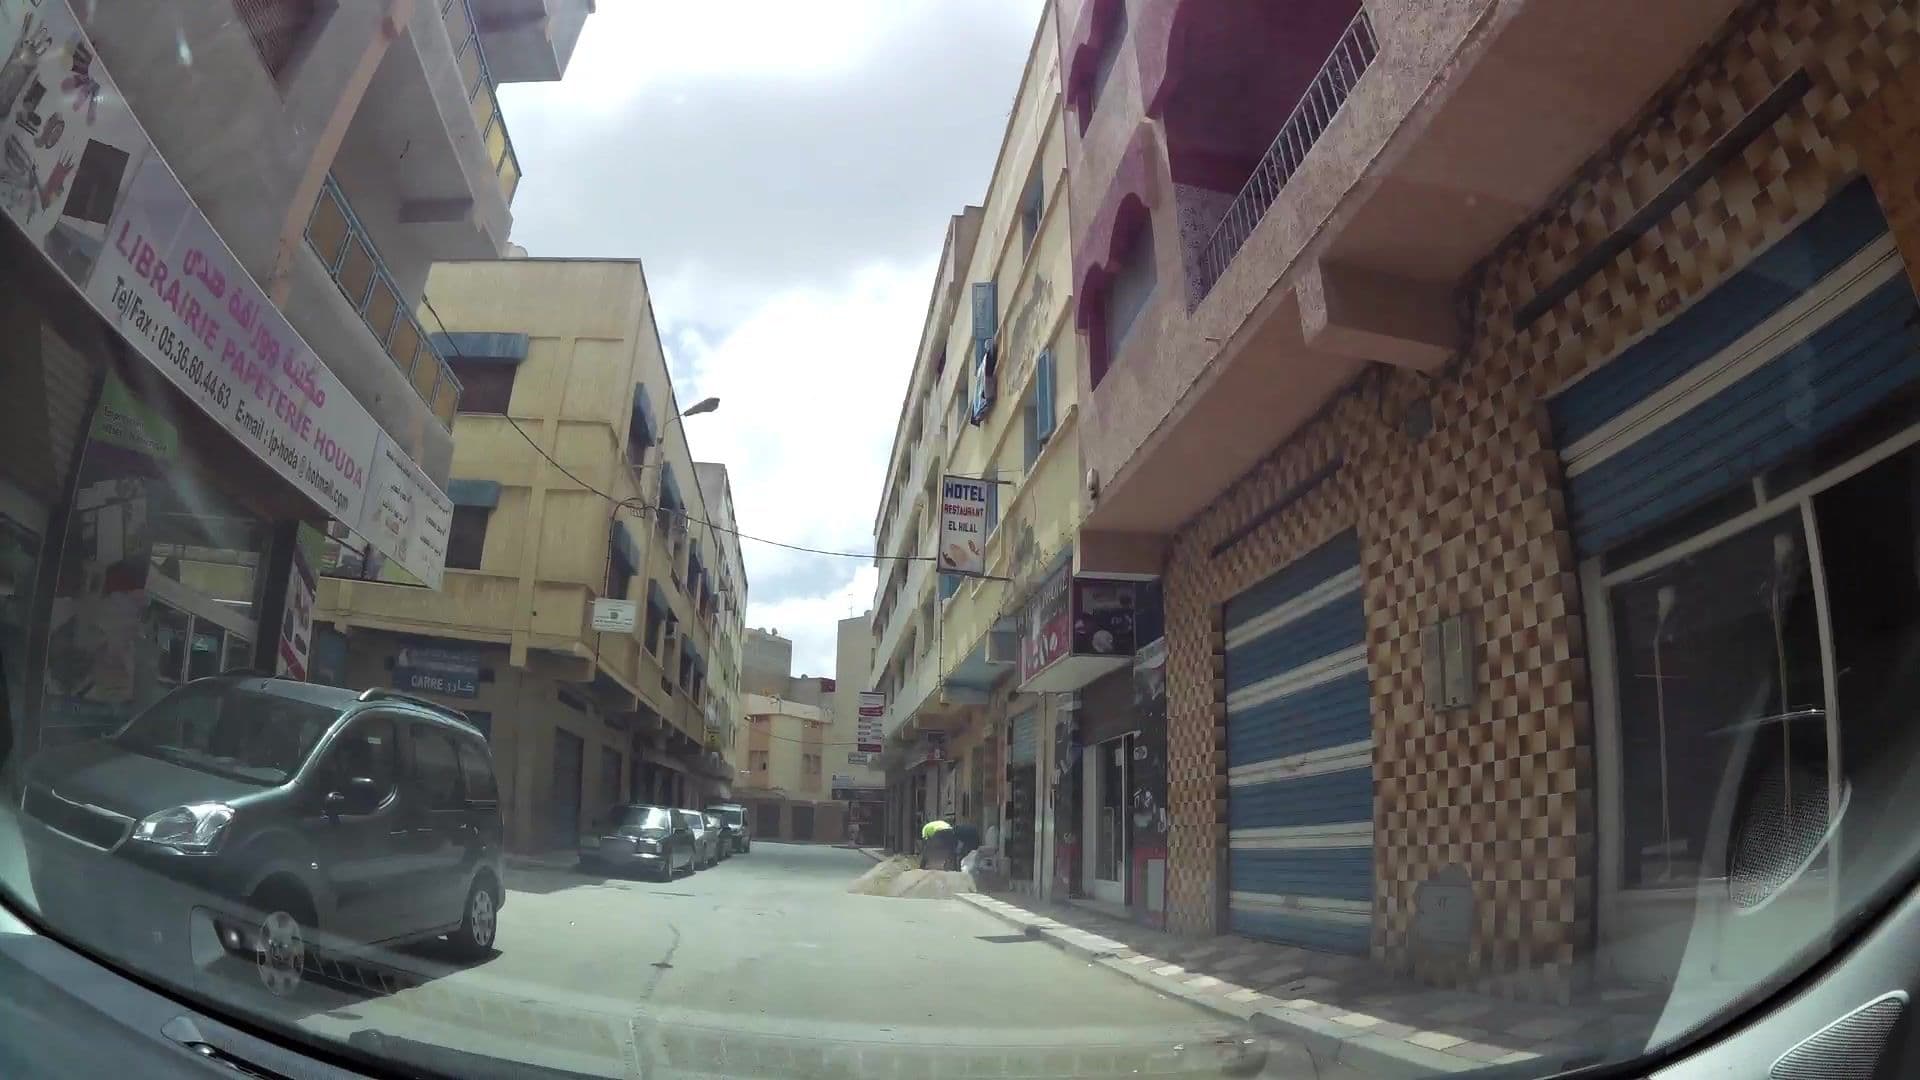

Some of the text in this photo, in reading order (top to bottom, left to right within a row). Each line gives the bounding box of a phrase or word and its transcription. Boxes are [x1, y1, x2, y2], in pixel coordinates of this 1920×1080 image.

[116, 219, 221, 352] LIBRAIRIE
[221, 337, 312, 442] PAPETERIE
[312, 427, 363, 489] HOUDA
[183, 247, 326, 409] مكتبة ووراقة هدى
[157, 325, 232, 410] 05.36.60.44.63
[944, 503, 984, 518] RESTAURANT
[945, 482, 985, 502] HOTEL
[948, 520, 978, 533] EL HILAL
